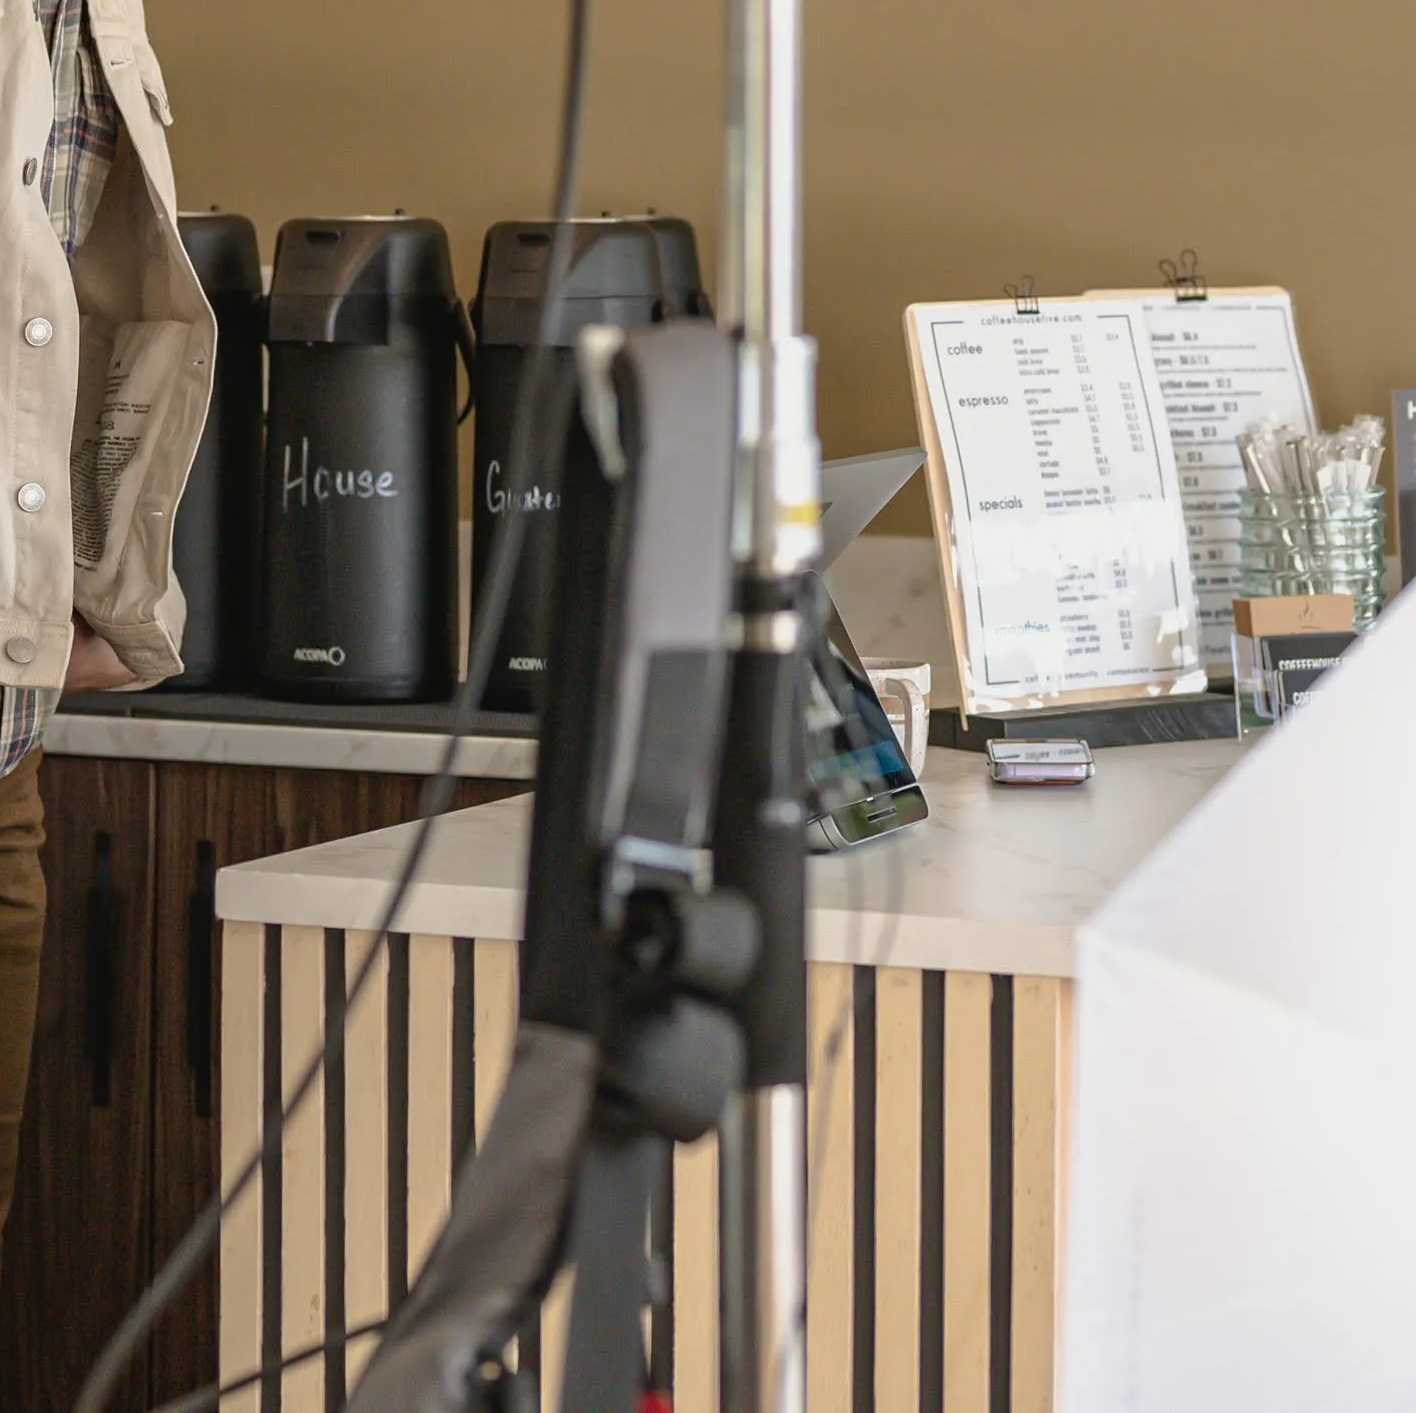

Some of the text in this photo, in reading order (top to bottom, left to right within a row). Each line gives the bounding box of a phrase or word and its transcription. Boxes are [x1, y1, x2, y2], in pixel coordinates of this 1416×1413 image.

[981, 314, 1083, 326] coffeehousefive.com
[947, 341, 983, 356] coffee
[958, 395, 1009, 409] espresso
[283, 436, 399, 513] House
[979, 495, 1024, 512] specials
